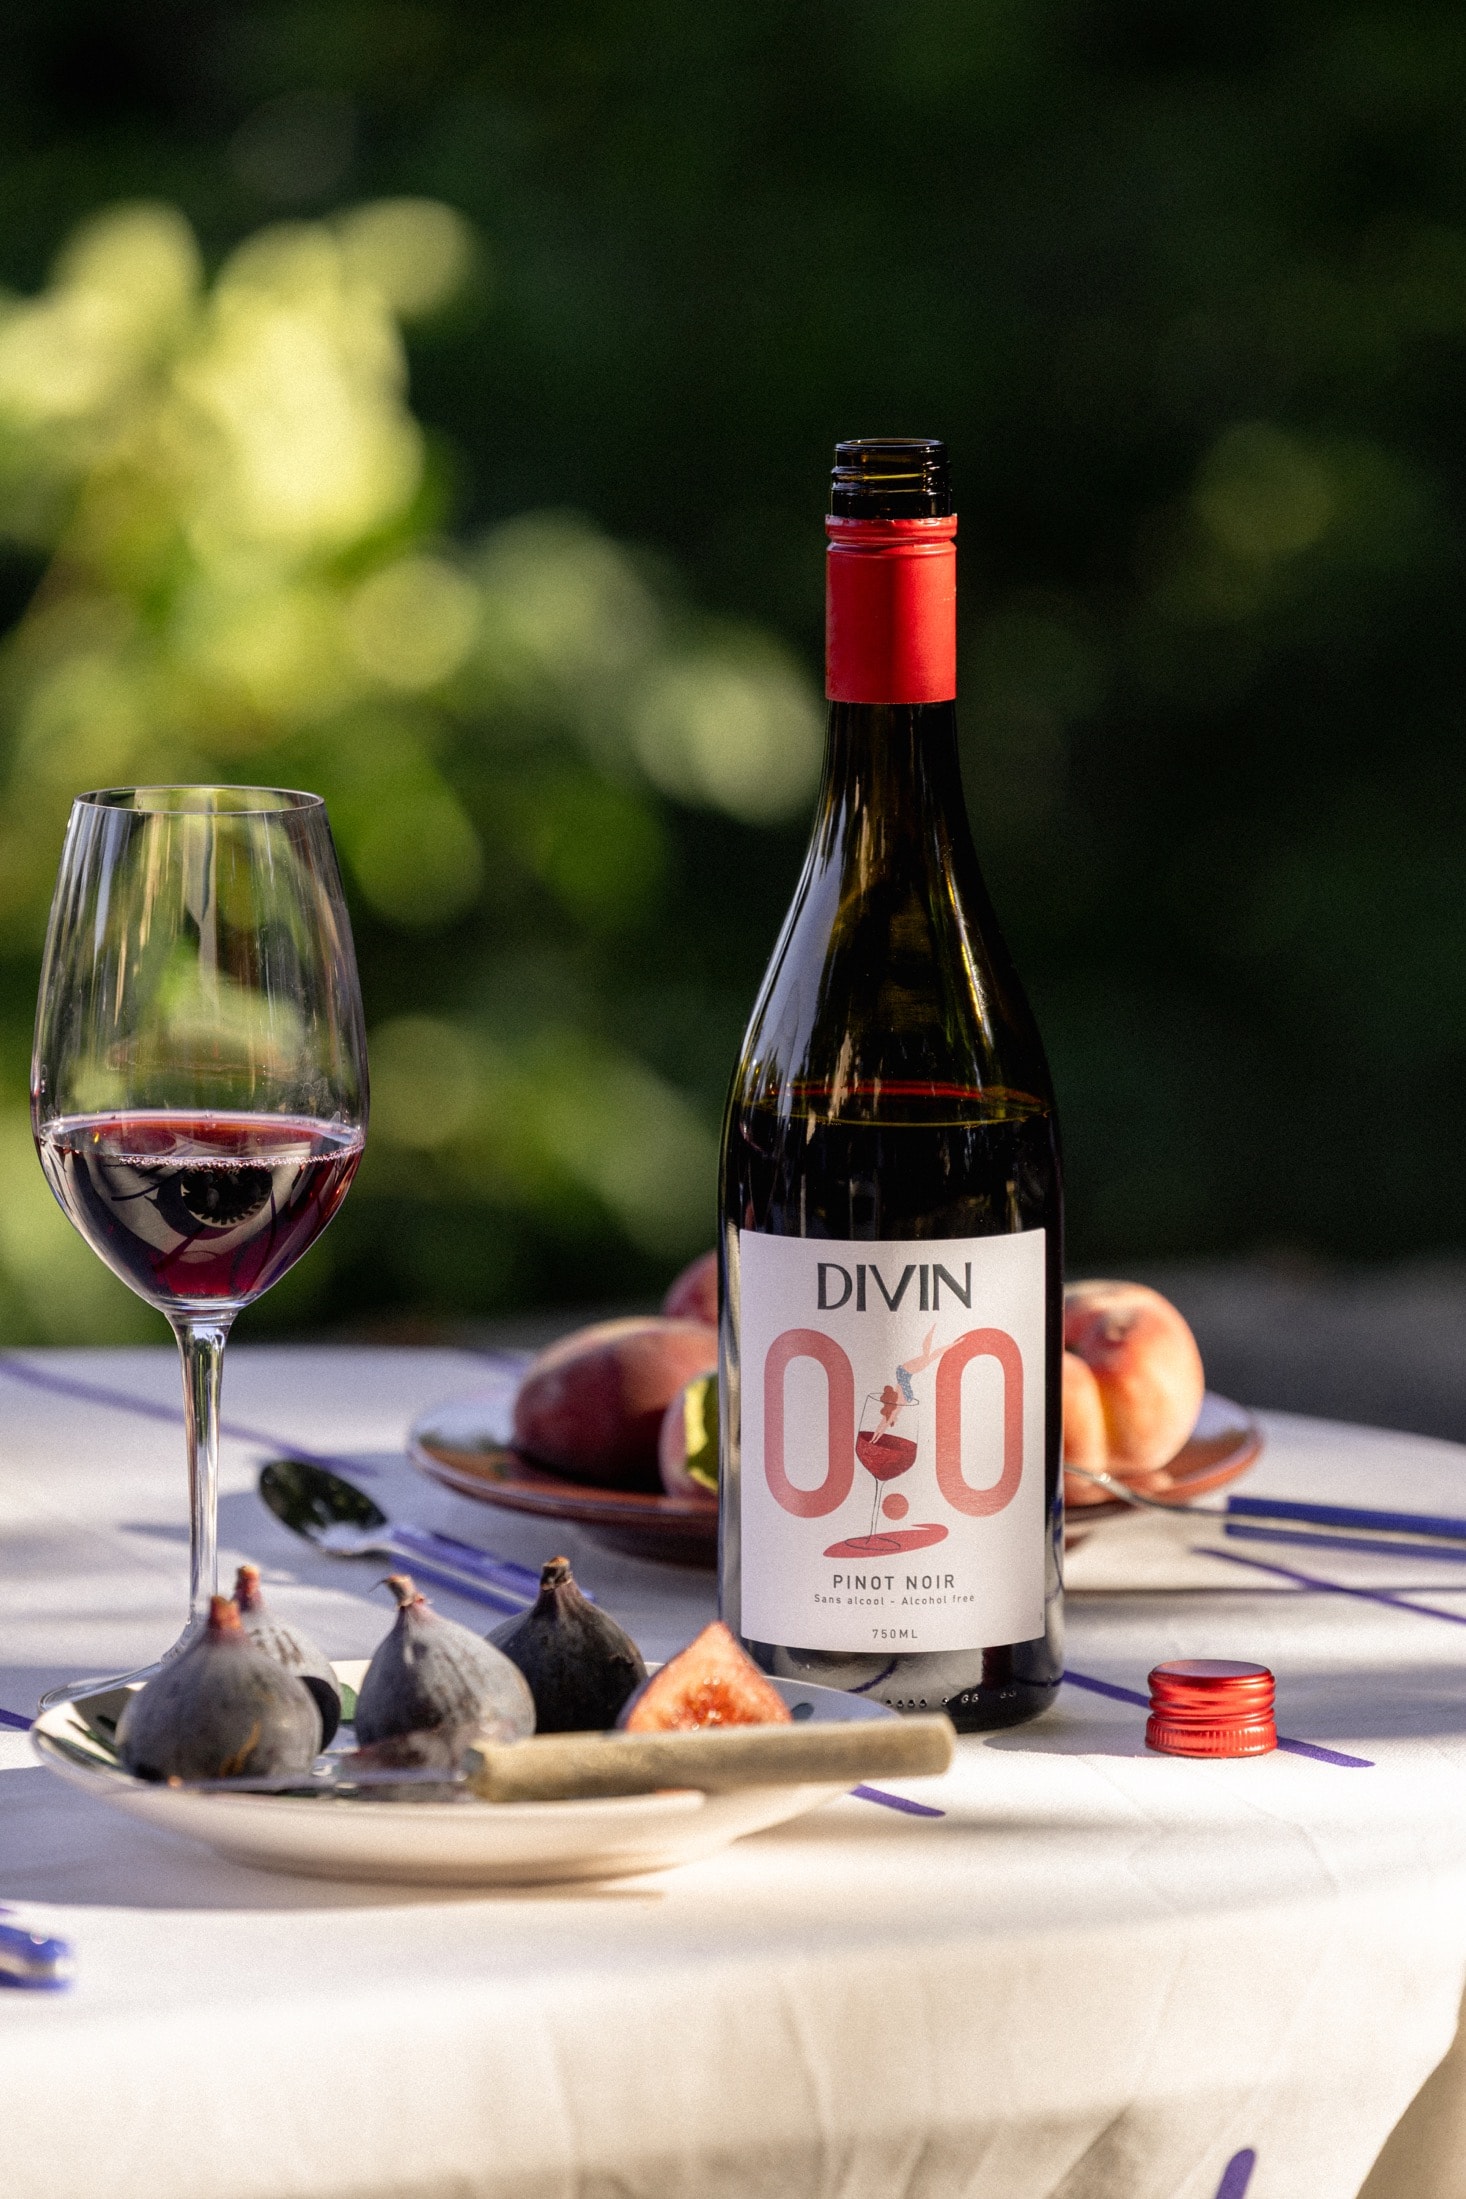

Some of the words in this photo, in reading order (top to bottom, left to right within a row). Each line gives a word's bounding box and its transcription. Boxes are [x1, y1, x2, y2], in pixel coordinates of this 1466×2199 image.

[817, 1262, 972, 1311] DIVIN
[833, 1574, 895, 1590] PINOT
[906, 1574, 955, 1590] NOIR
[814, 1594, 841, 1604] Sans
[847, 1596, 884, 1606] alcool
[901, 1595, 947, 1606] Alcohol
[952, 1594, 975, 1603] free
[872, 1629, 918, 1639] 750ML
